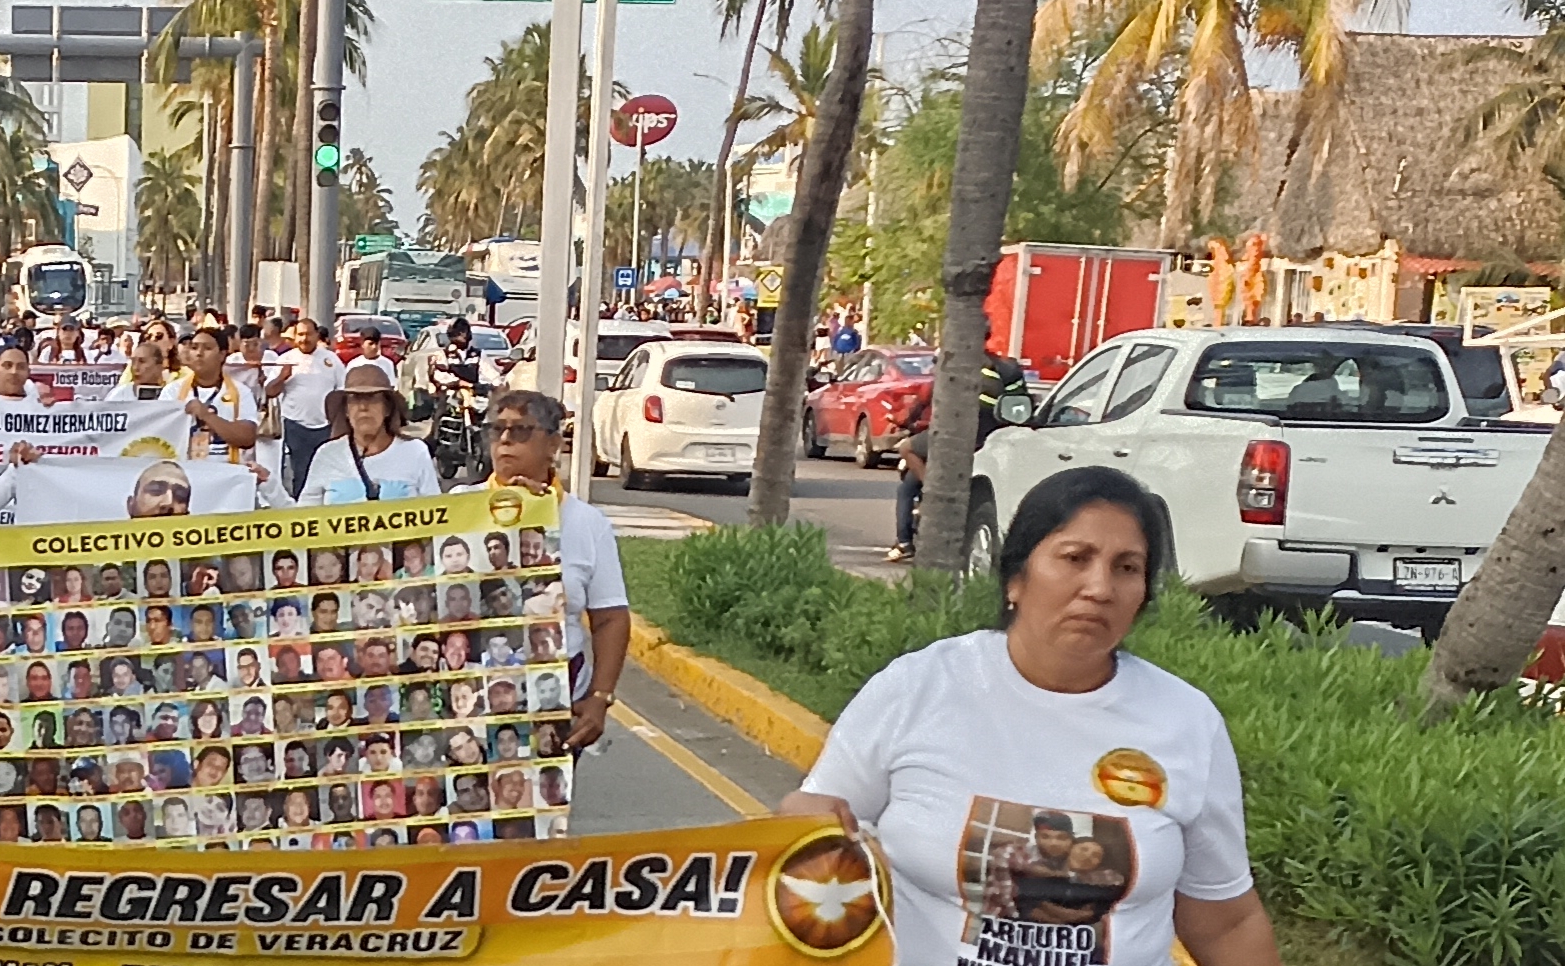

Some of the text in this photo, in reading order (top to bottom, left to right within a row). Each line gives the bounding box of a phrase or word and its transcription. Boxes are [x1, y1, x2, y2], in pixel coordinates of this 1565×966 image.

[629, 107, 676, 133] ips
[4, 412, 50, 433] GOMEZ
[33, 507, 449, 555] COLECTIVO SOLECITO DE VERACRUZ
[3, 869, 406, 925] REGRESAR
[424, 866, 480, 921] A
[510, 851, 759, 917] CASA!
[189, 928, 237, 953] DE
[256, 926, 466, 955] VERACRUZ
[981, 917, 1095, 951] ARTURO
